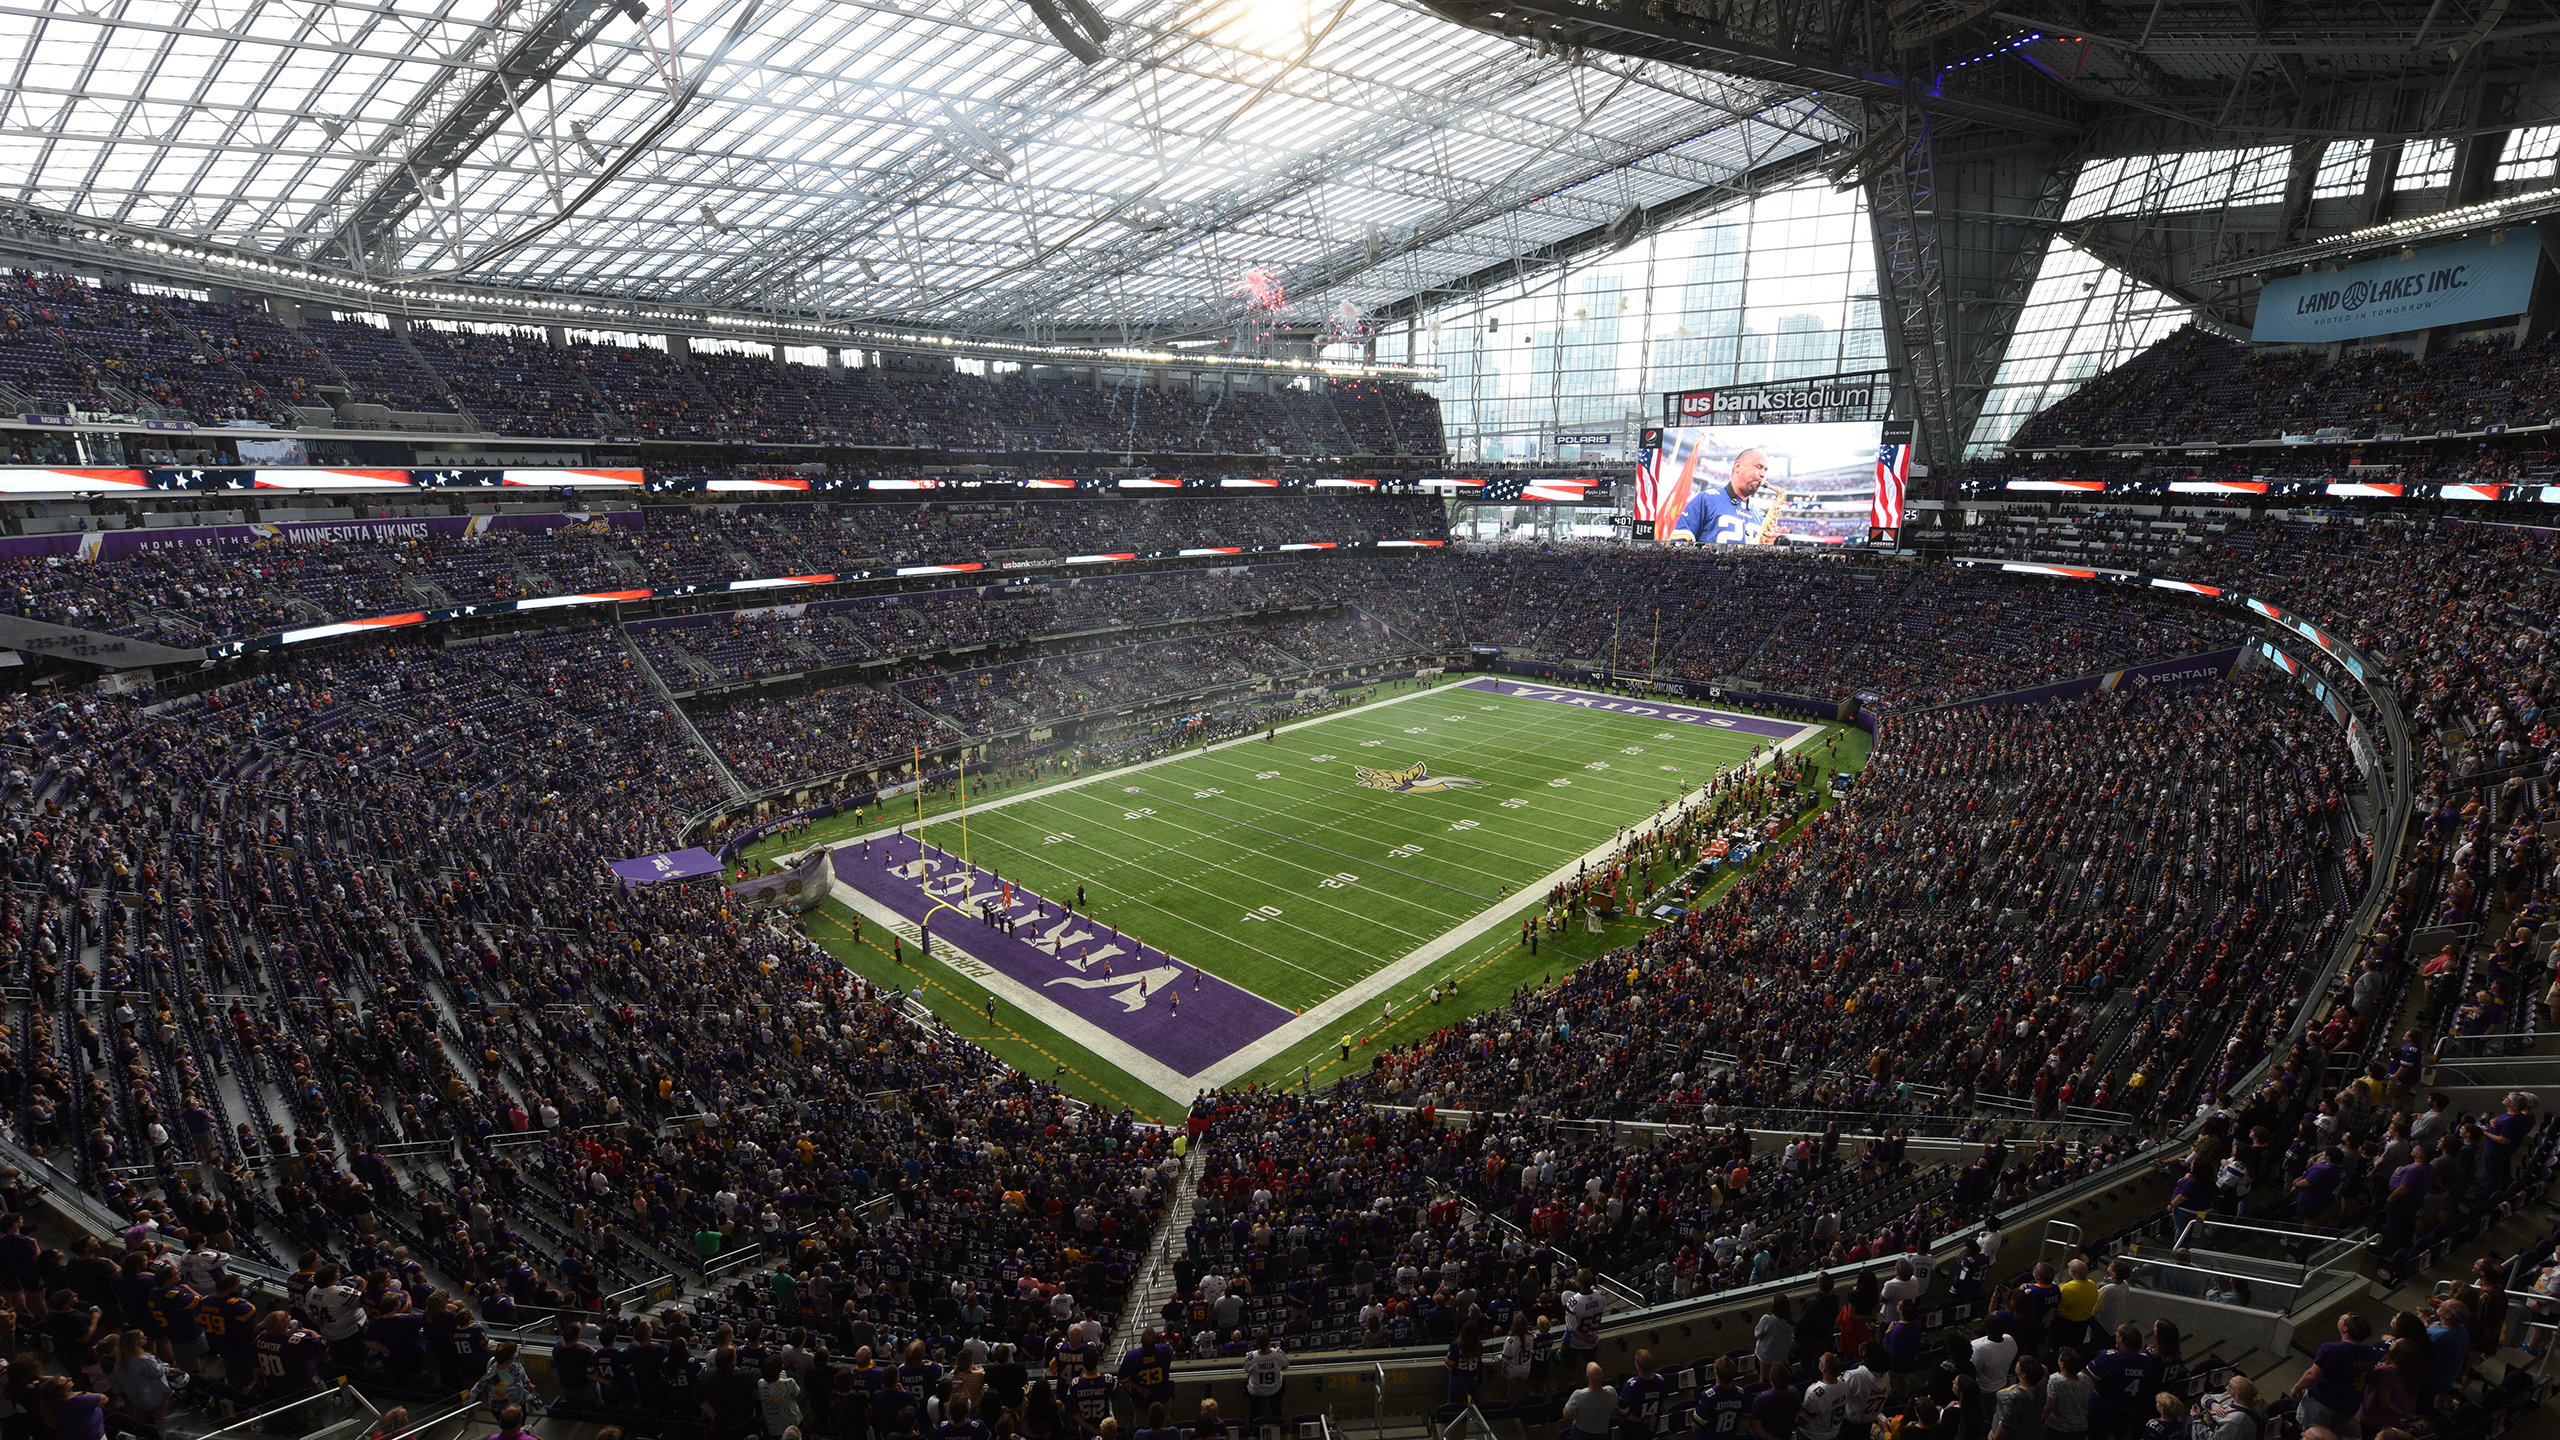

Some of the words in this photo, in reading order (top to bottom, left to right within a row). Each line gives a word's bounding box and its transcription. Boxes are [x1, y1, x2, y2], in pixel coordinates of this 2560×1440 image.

[2296, 290, 2340, 315] LAND
[2426, 265, 2468, 293] INC.
[2314, 315, 2351, 326] ROOTED
[2356, 312, 2366, 320] IN
[2372, 302, 2432, 317] TOMORROW
[1557, 435, 1608, 444] POLARIS
[813, 503, 830, 513] SKOL
[1904, 510, 1918, 520] 25
[1614, 517, 1632, 526] 4:07
[140, 540, 184, 551] HOME
[195, 537, 213, 547] OF
[220, 536, 250, 546] THE
[288, 525, 369, 545] MINNESOTA
[373, 522, 428, 540] VIKINGS
[1635, 524, 1653, 535] Lite
[25, 635, 88, 649] 225-242
[72, 642, 126, 656] 122-141
[2151, 667, 2218, 683] PENTAIR
[703, 688, 722, 696] sleep
[1512, 687, 1738, 728] VIKINGS
[1500, 797, 1529, 809] 50
[1124, 806, 1157, 820] 20
[1450, 819, 1480, 831] 40
[1043, 832, 1076, 845] 10
[1390, 843, 1424, 859] 30
[1321, 872, 1360, 889] 20
[1246, 905, 1284, 923] 10
[888, 857, 1184, 1013] VIKINGS
[859, 1260, 874, 1270] 12
[886, 1264, 901, 1276] 88
[1916, 1268, 1928, 1279] 18
[653, 1282, 673, 1302] 116
[1585, 1300, 1600, 1312] ALLEN
[195, 1313, 226, 1335] 99
[1498, 1312, 1509, 1322] 19
[1578, 1311, 1602, 1334] 69
[454, 1340, 473, 1354] 18
[257, 1352, 286, 1376] 80
[741, 1356, 759, 1365] SMITH
[1058, 1352, 1084, 1362] BROWN
[1143, 1355, 1156, 1365] COOK
[1257, 1362, 1275, 1370] THIELEN
[2124, 1367, 2144, 1377] COOK
[2352, 1361, 2374, 1371] FAVR
[901, 1374, 924, 1383] THIELEN
[1138, 1366, 1164, 1385] 33
[1258, 1371, 1275, 1385] 19
[2162, 1364, 2181, 1383] 19
[1328, 1375, 1357, 1388] 219
[2124, 1378, 2141, 1397] 4
[2352, 1370, 2369, 1392] 4
[1076, 1387, 1106, 1398] GREENWAY
[1077, 1399, 1106, 1419] 52
[1640, 1401, 1659, 1419] 14
[1714, 1401, 1743, 1411] JEFFERSON
[1865, 1397, 1887, 1415] 27
[1715, 1411, 1737, 1433] 18
[1829, 1405, 1846, 1426] 19
